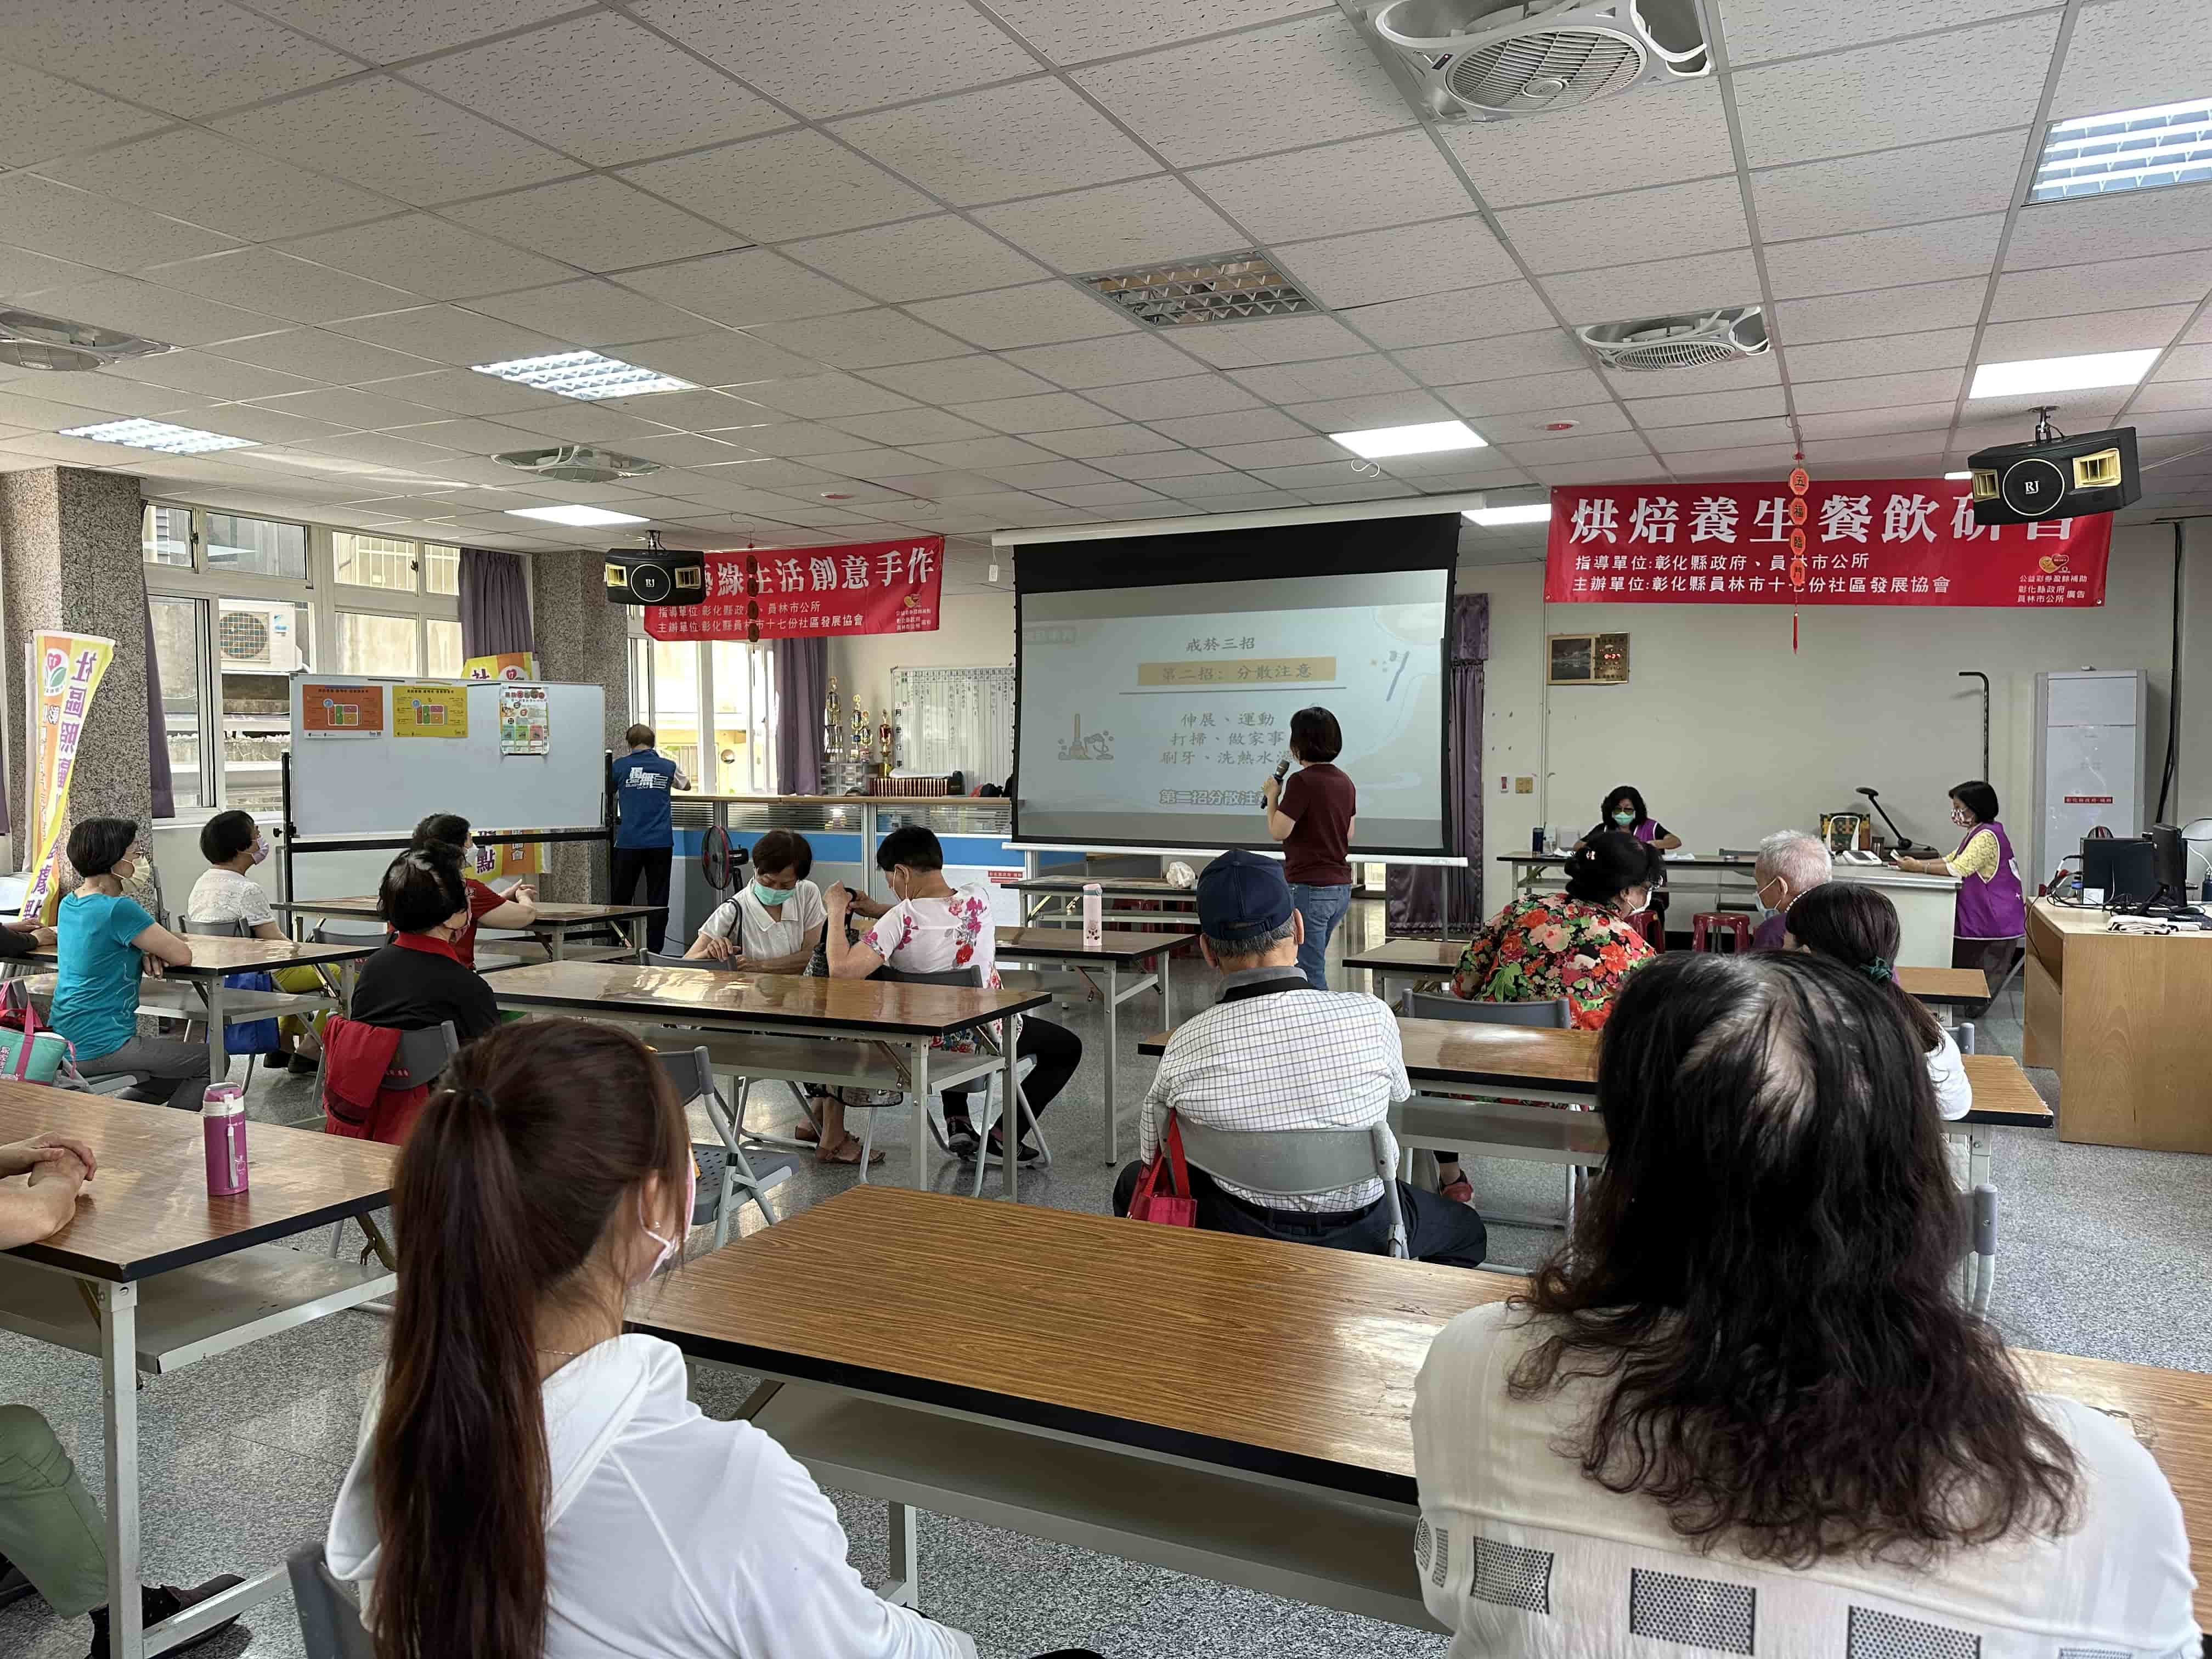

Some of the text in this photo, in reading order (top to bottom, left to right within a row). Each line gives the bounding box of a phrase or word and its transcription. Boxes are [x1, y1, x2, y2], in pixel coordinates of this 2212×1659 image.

[2025, 481, 2039, 494] RJ
[704, 547, 935, 597] 綠生活創意手作
[2018, 585, 2066, 594] 彰化縣政府
[2017, 595, 2065, 603] 員林市公所
[658, 601, 821, 618] 指導單位:彰化縣政、員林市公所
[1186, 636, 1255, 652] 戒菸三招
[1181, 712, 1274, 728] 伸展、運動
[1169, 731, 1284, 747] 打掃、做家事
[1159, 789, 1265, 806] 第二招分散注
